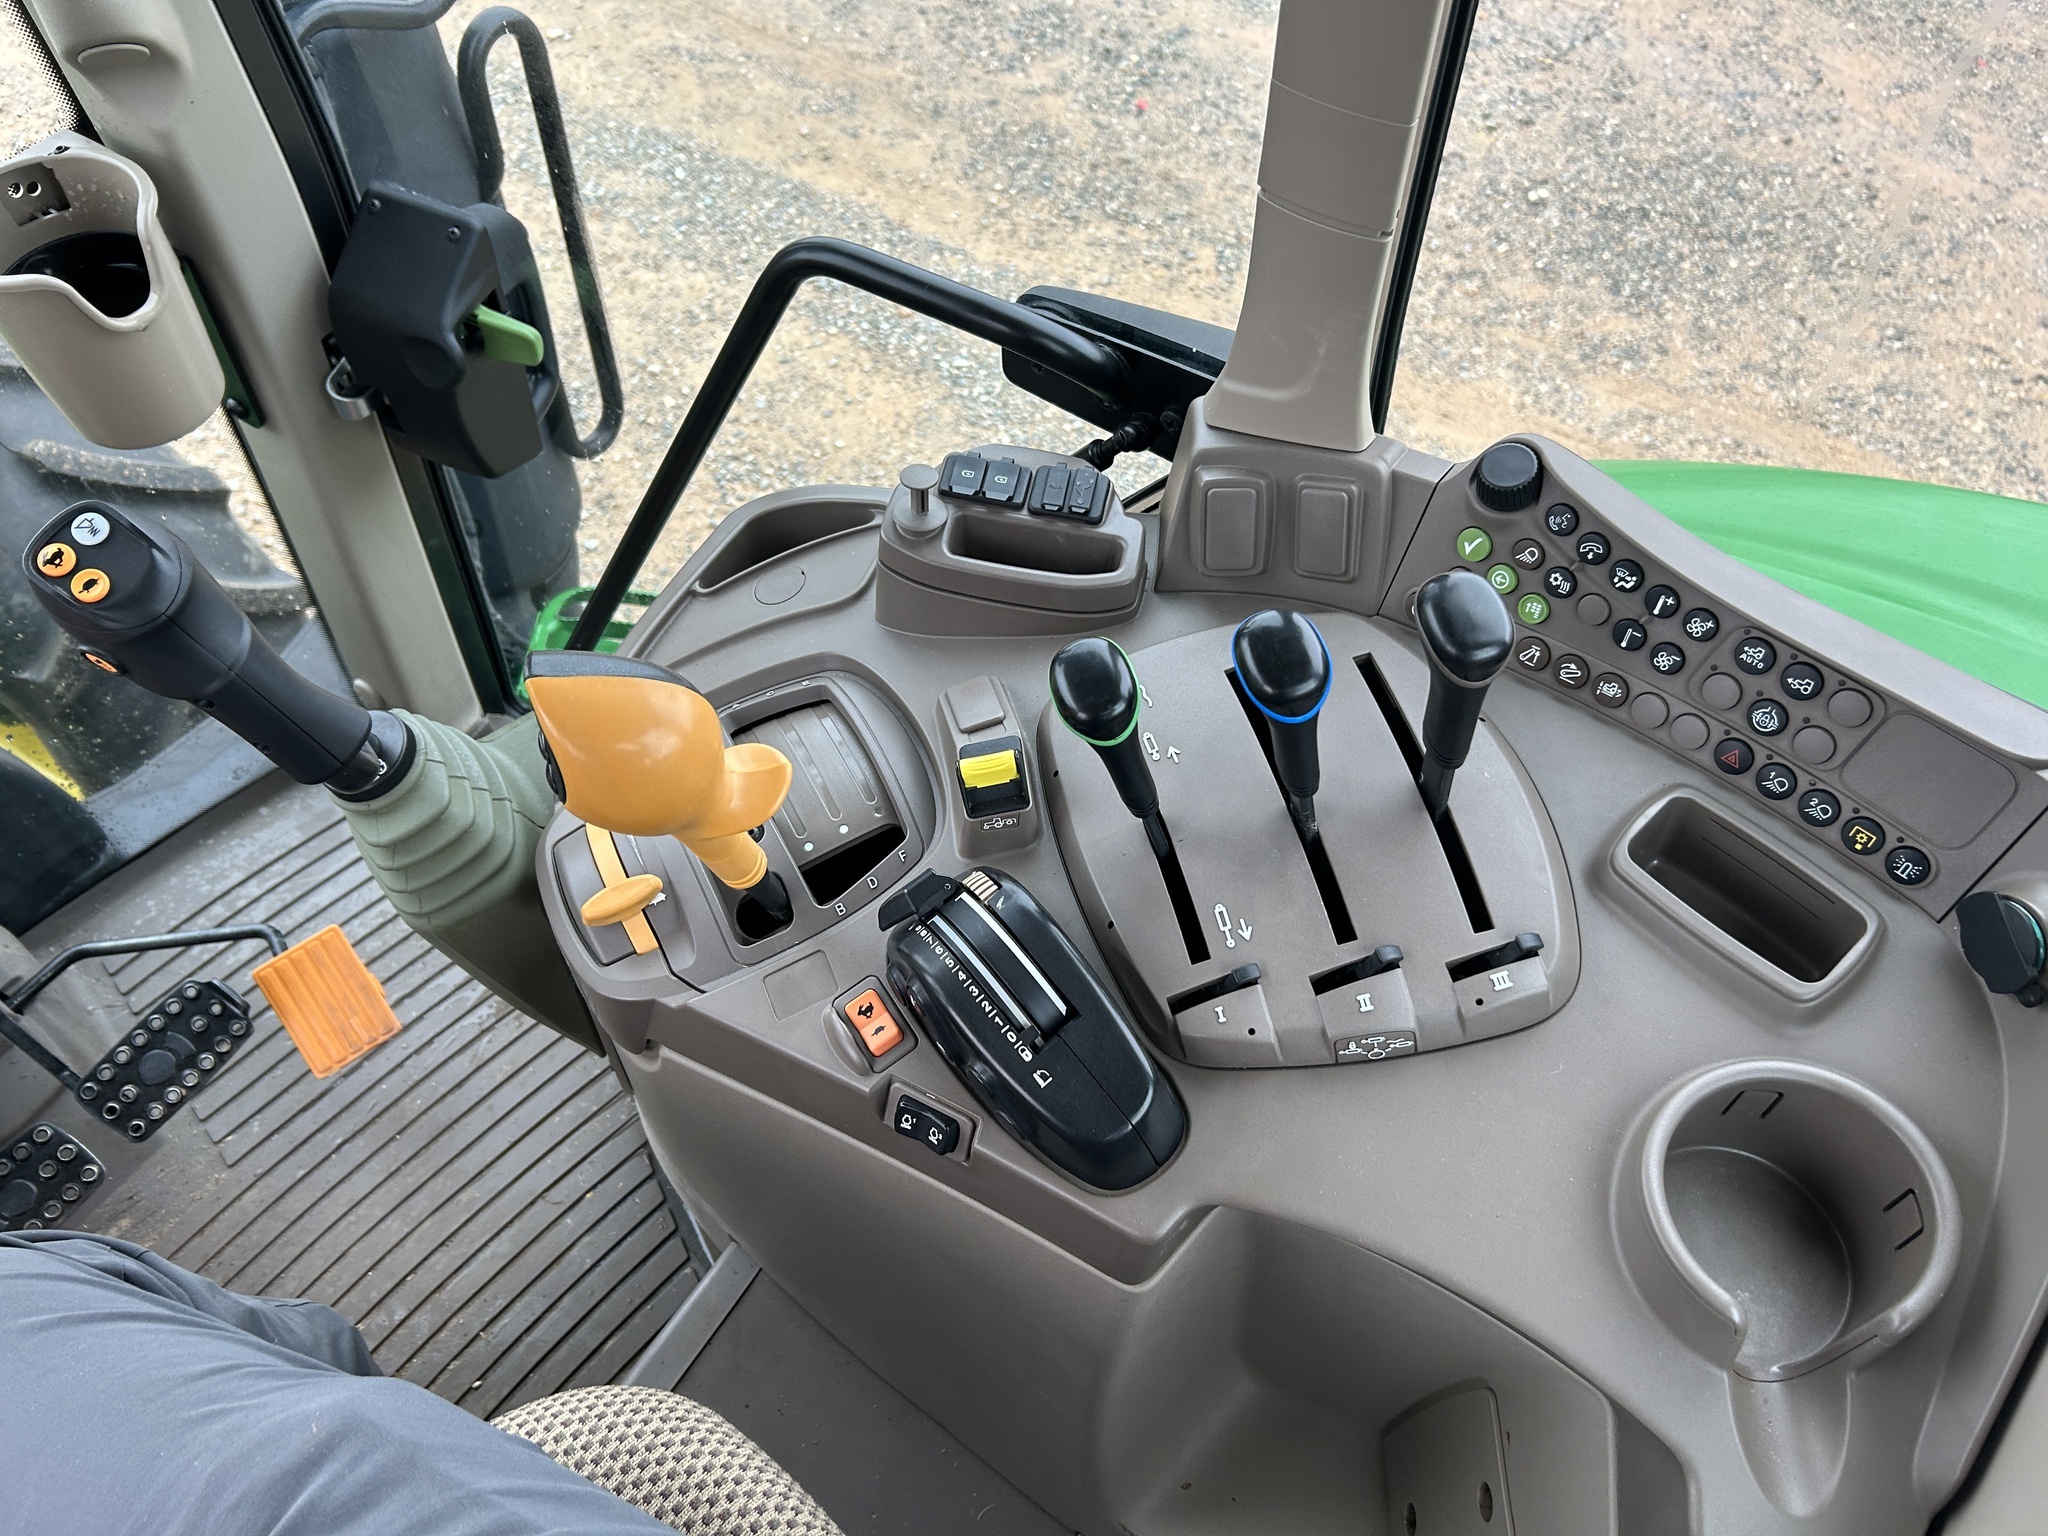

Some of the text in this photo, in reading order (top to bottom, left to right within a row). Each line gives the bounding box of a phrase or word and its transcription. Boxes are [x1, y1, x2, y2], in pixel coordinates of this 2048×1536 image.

[1738, 653, 1764, 669] AUTO
[1769, 771, 1776, 779] 1
[1809, 798, 1819, 807] 2
[835, 849, 907, 916] B D F
[926, 935, 933, 945] 7
[935, 945, 944, 955] 6
[945, 956, 955, 968] 5
[958, 971, 966, 981] 4
[969, 985, 979, 996] 3
[981, 1000, 992, 1013] 2
[994, 1016, 1004, 1027] 1
[1006, 1031, 1017, 1043] 0
[1490, 970, 1514, 992] III
[1356, 993, 1375, 1013] II
[1214, 1005, 1227, 1023] I
